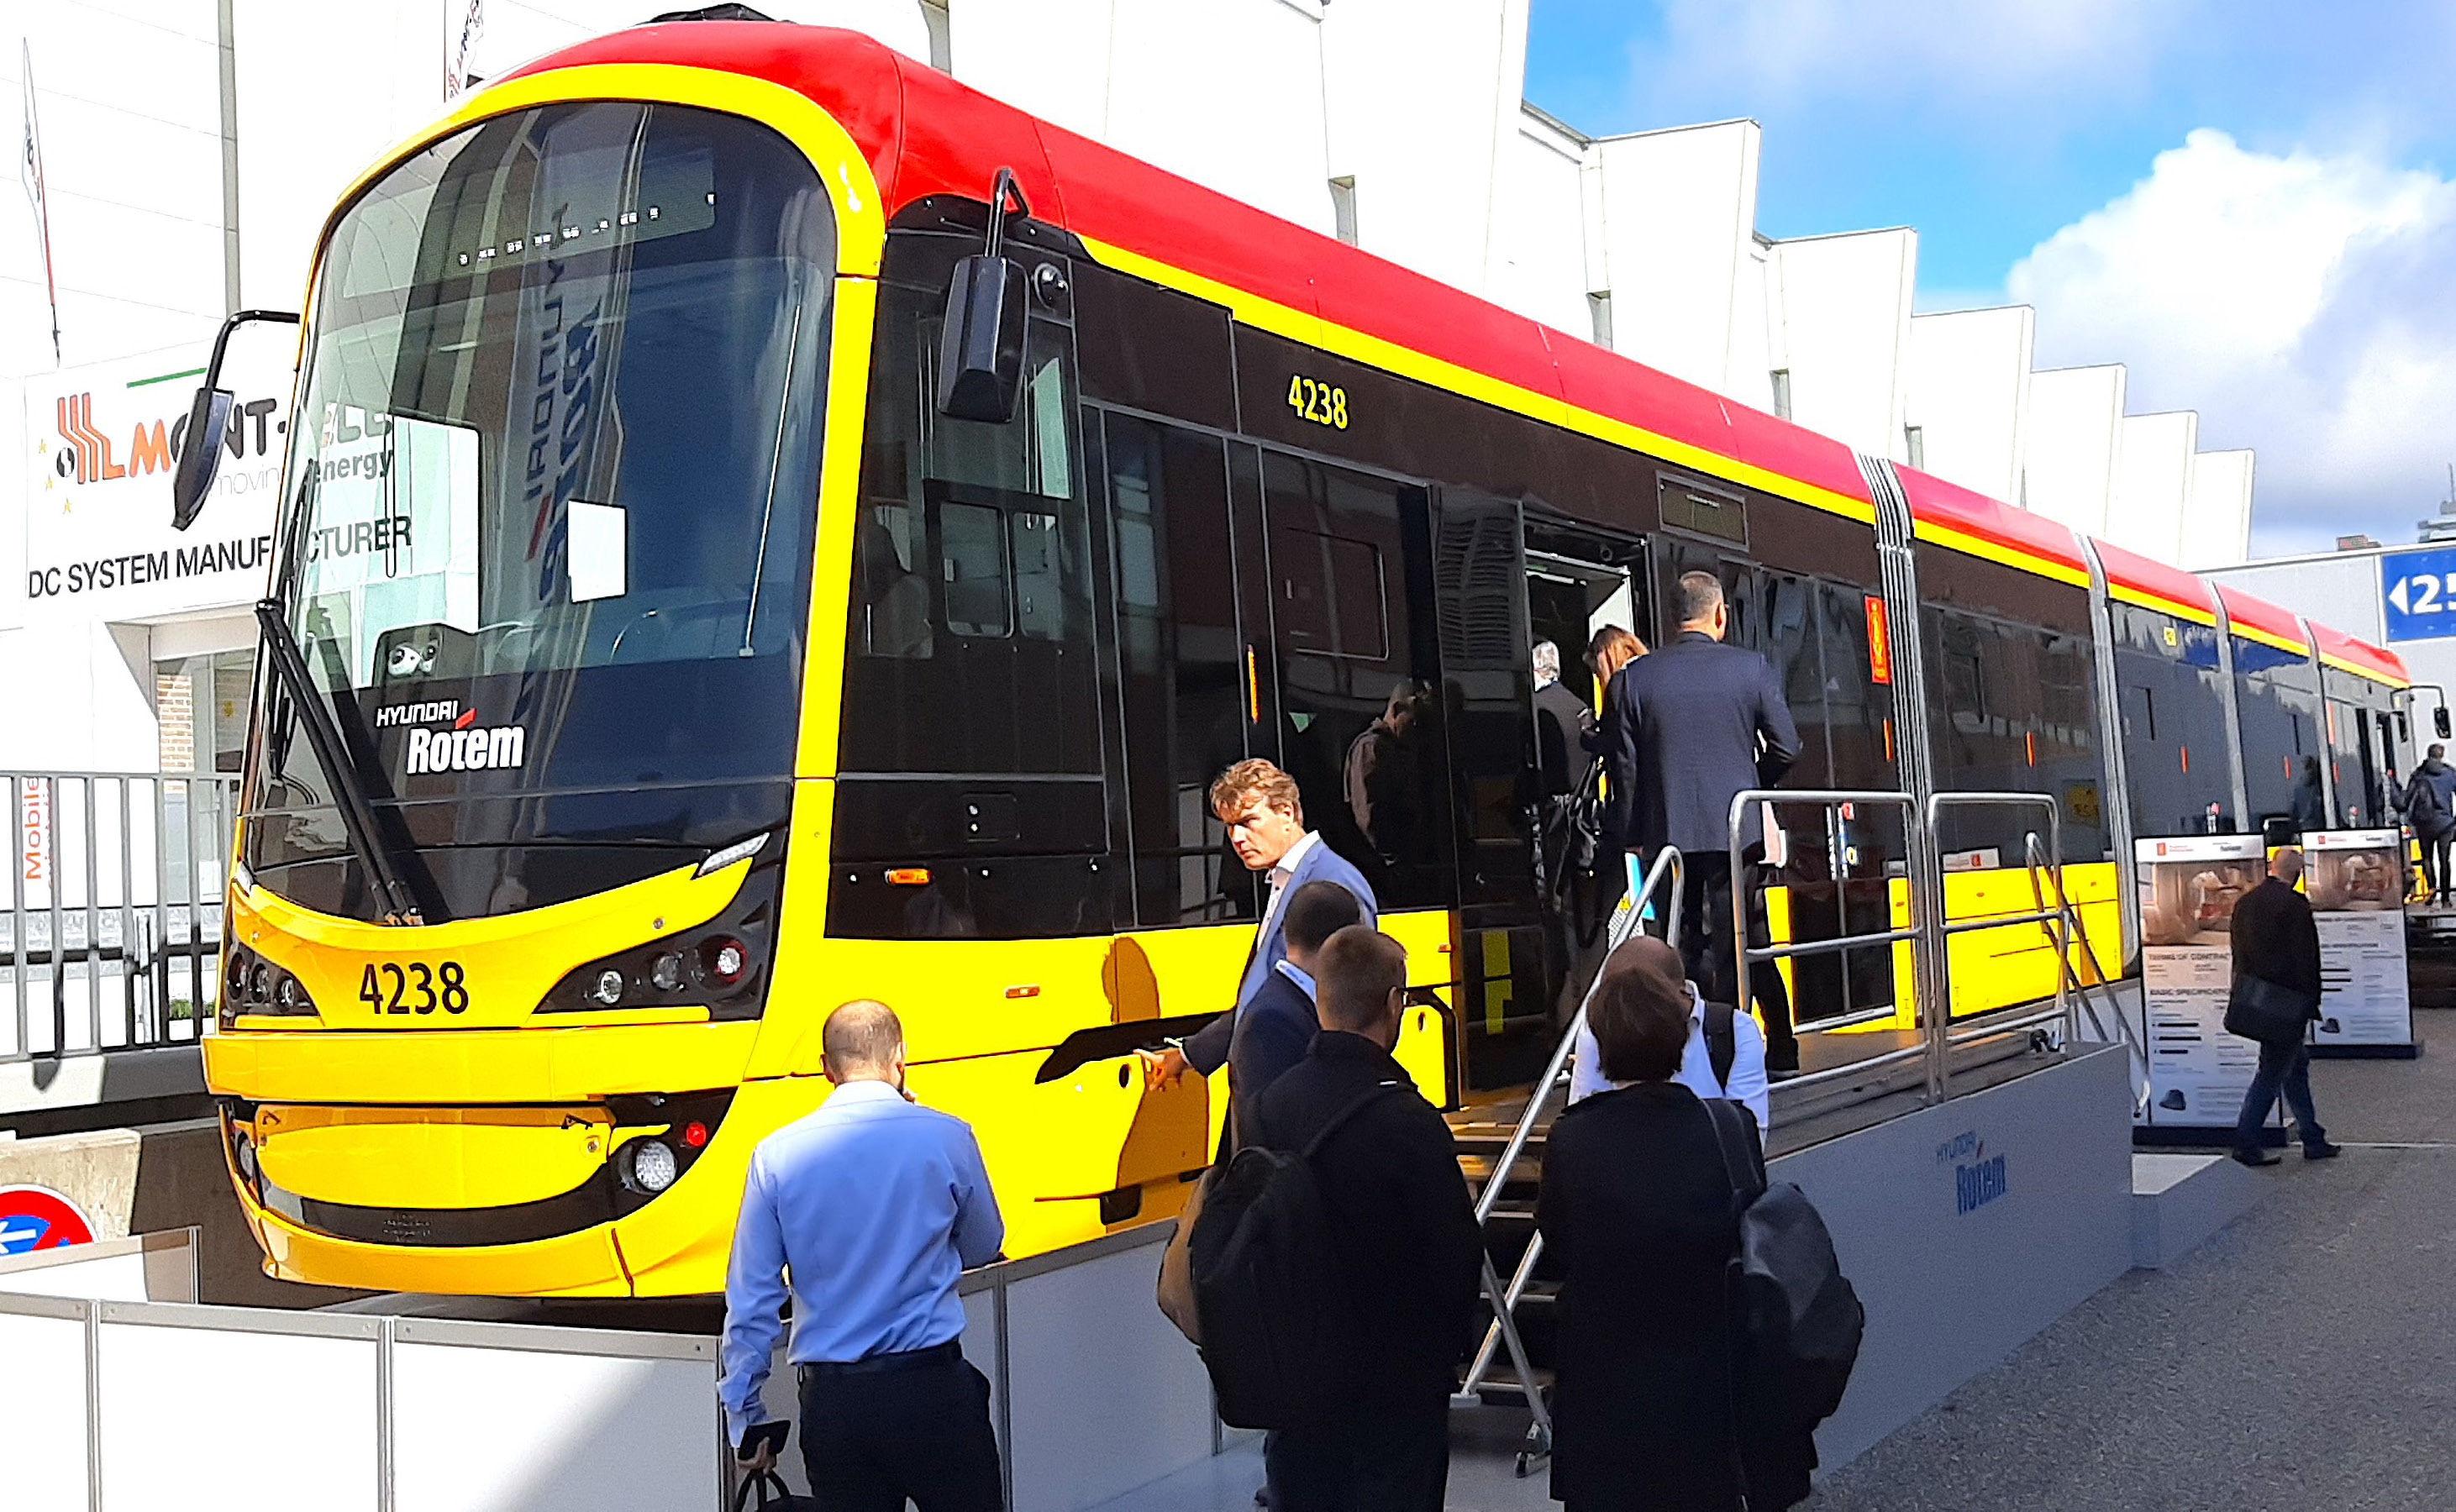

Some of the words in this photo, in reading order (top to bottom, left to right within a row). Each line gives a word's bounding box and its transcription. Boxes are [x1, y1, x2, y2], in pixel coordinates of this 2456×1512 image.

[1288, 375, 1348, 429] 4238
[322, 449, 393, 482] nergy
[29, 566, 61, 599] DC
[67, 550, 169, 593] SYSTEM
[176, 516, 413, 578] MANUFCTURER
[376, 700, 459, 727] HYUNDAI
[407, 726, 524, 774] Rotem
[360, 961, 469, 1015] 4238
[1956, 1152, 2006, 1216] Rotem
